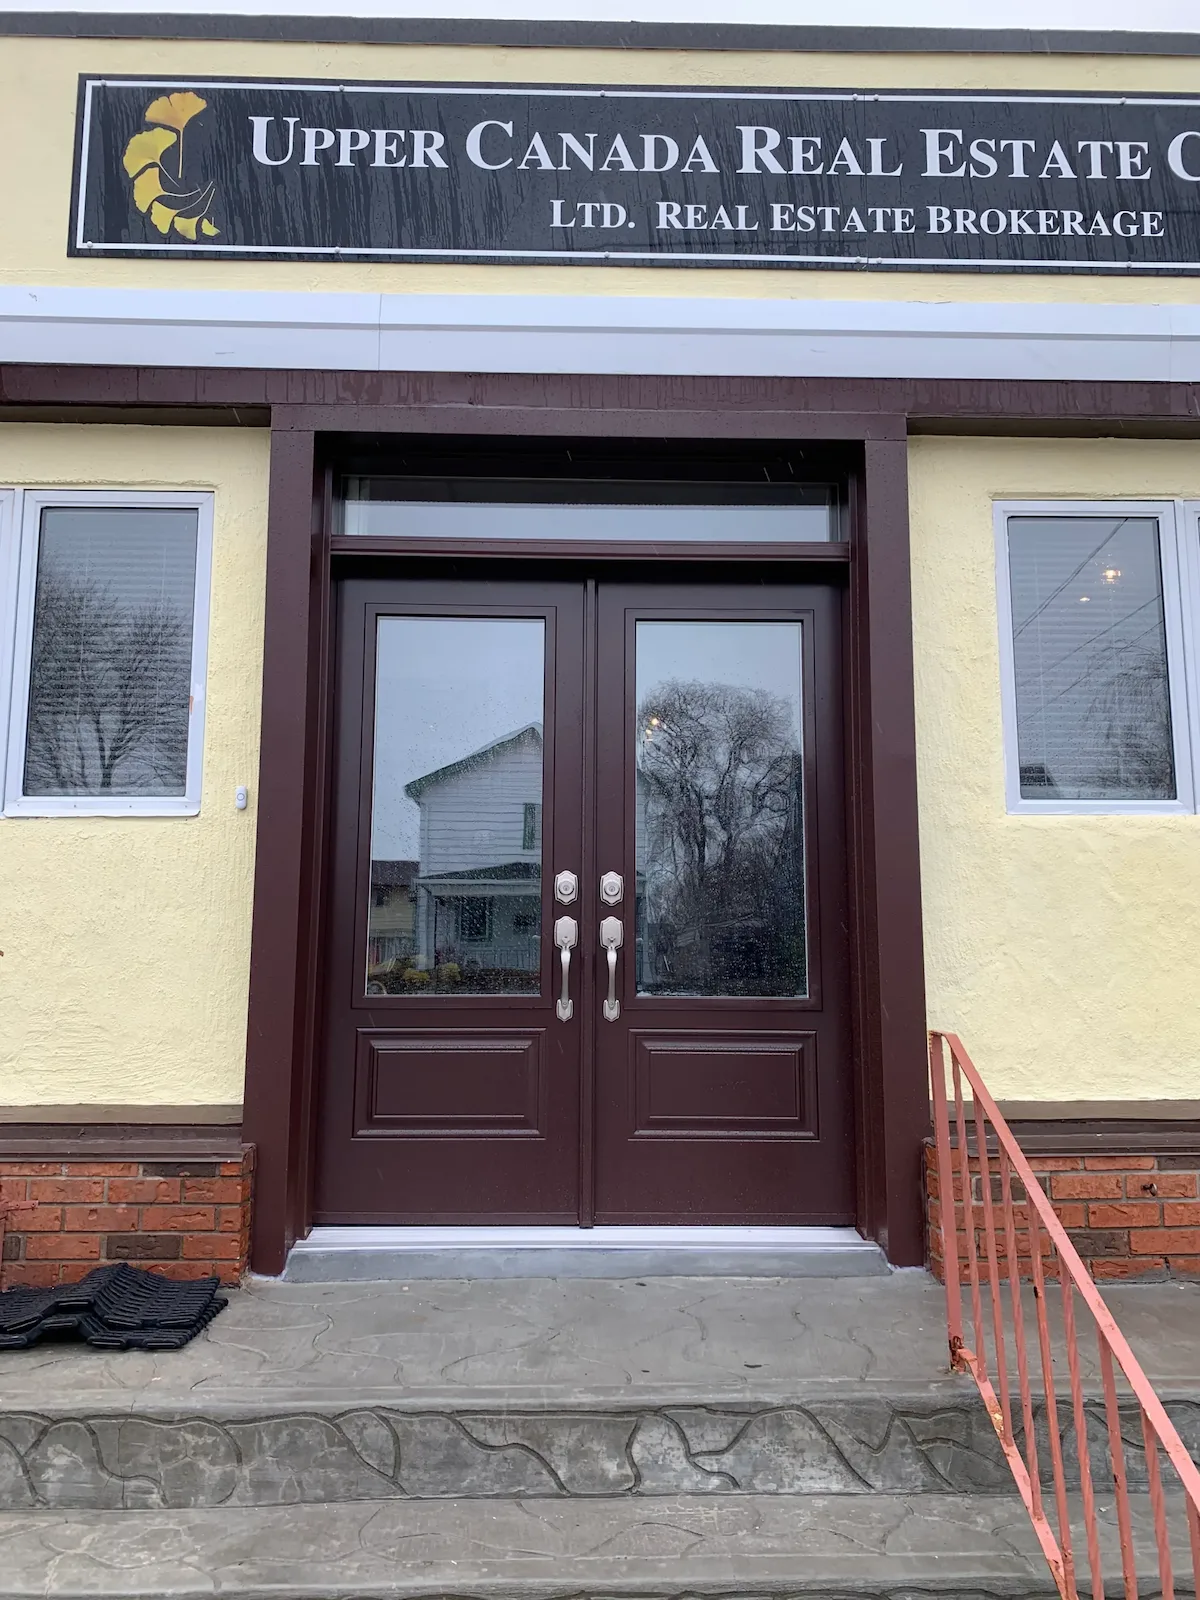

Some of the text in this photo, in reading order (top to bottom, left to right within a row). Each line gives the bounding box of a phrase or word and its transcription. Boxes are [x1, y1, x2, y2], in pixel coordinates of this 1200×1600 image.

[249, 116, 449, 169] UPPER
[465, 120, 721, 173] CANADA
[736, 125, 904, 177] REAL
[919, 128, 1152, 180] ESTATE
[550, 199, 1165, 237] LTD. REAL ESTATE BROKERAGE
